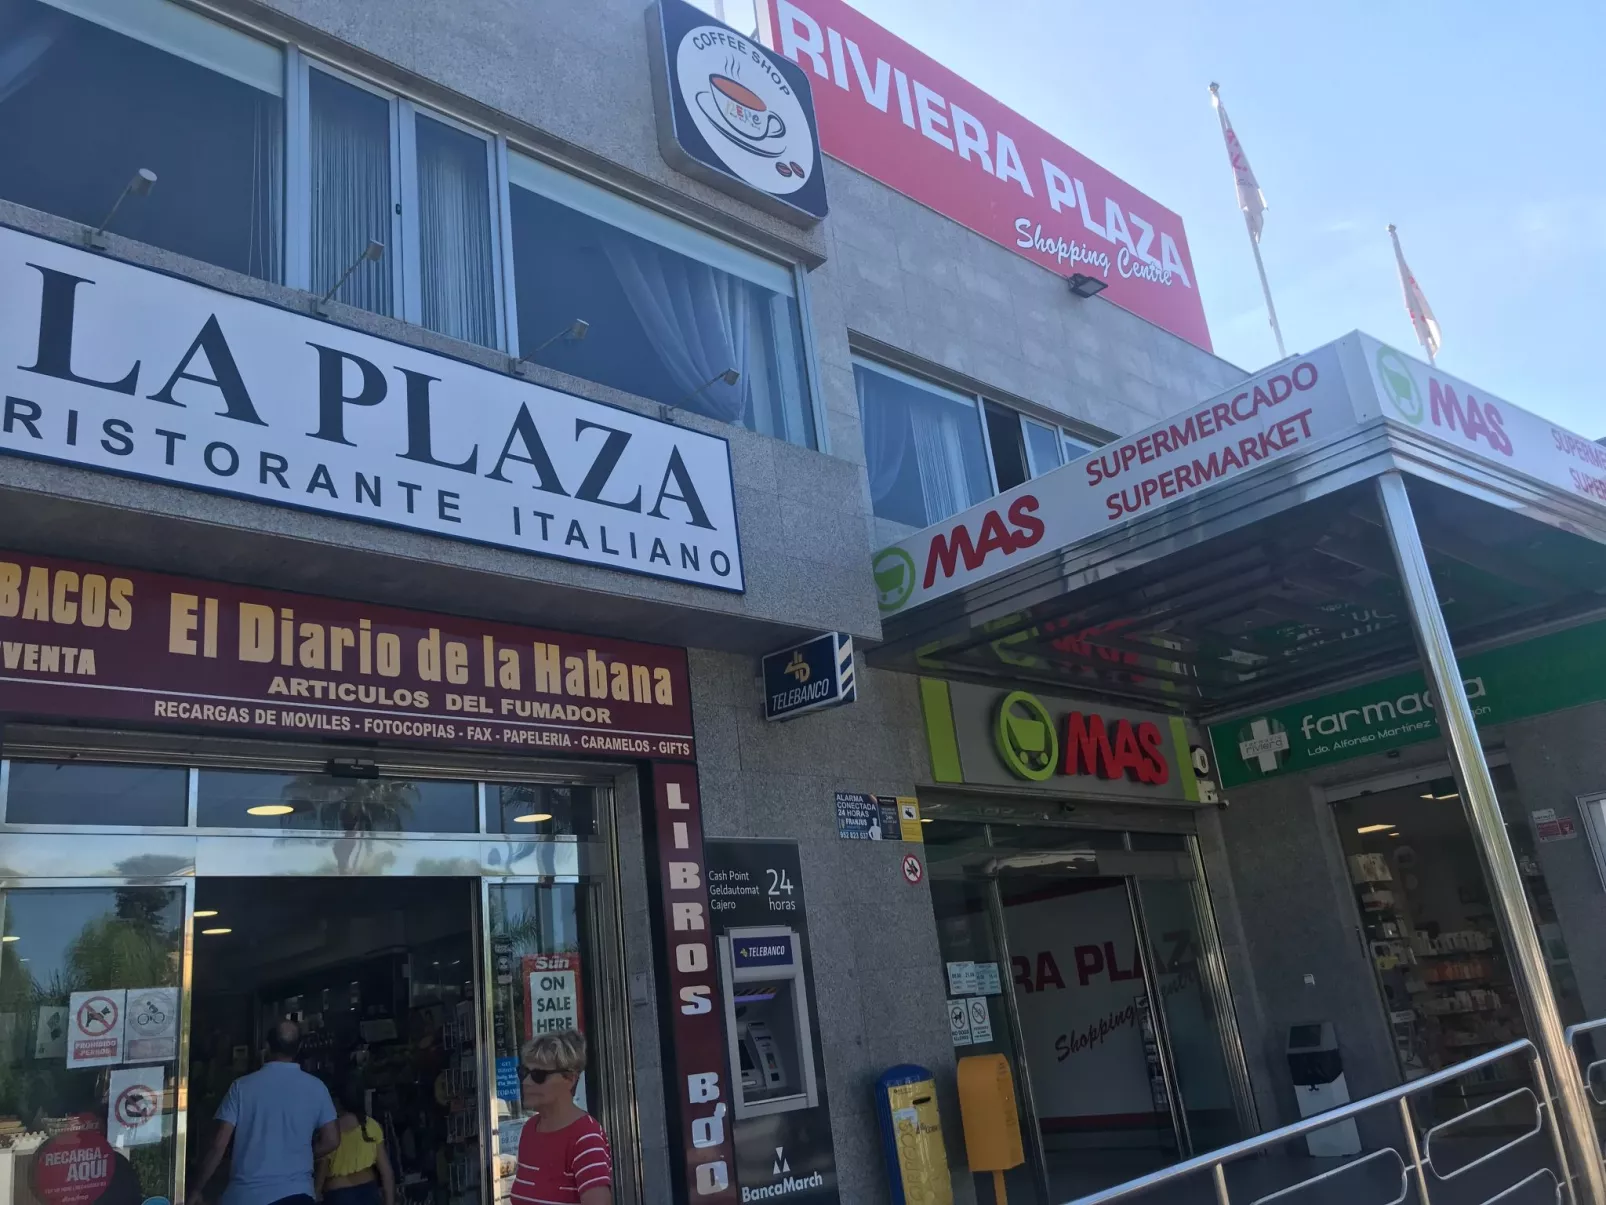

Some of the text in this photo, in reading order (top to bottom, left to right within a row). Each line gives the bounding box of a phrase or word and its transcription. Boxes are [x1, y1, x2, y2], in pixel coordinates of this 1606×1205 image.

[692, 31, 791, 96] COFFEE SHOP
[777, 0, 1191, 288] RIVIERA PLAZA
[1014, 217, 1173, 287] Shopping Centre
[17, 262, 718, 531] LA PLAZA
[1086, 362, 1318, 486] SUPERMERCADO
[1429, 377, 1514, 457] MAS
[1106, 408, 1313, 521] SUPERMARKET
[3, 395, 732, 578] RISTORANTE ITALIANO
[923, 494, 1045, 589] MAS
[168, 592, 673, 706] El Diario de la Habana
[267, 676, 612, 724] ARTICULOS DEL FUMADOR
[772, 678, 830, 712] TELEBANCO
[154, 700, 690, 756] RECARGAS DE MOVILES FOTOCOPIAS FAX PAPELERIA CARAMELOS GIFTS
[1307, 745, 1330, 757] Ldo.
[1333, 734, 1376, 751] Alfonso
[1377, 718, 1432, 740] Martínez
[1063, 711, 1170, 786] MAS
[836, 794, 864, 802] ALARMA
[837, 802, 877, 811] CONECTADA
[838, 808, 869, 817] 24 HORAS
[709, 870, 750, 881] Cash Point
[709, 884, 760, 896] Geldautomat
[766, 869, 794, 896] 24
[666, 782, 712, 1016] LIBROS
[711, 900, 736, 912] Cajero
[769, 897, 796, 911] horas
[535, 956, 569, 970] Sun
[748, 945, 785, 957] TELEBANCO
[540, 976, 565, 991] ON
[537, 996, 571, 1013] SALE
[537, 1017, 572, 1033] HERE
[1055, 1004, 1137, 1063] Shopping
[45, 1147, 102, 1166] RECARGA
[742, 1171, 823, 1203] BancaMarch
